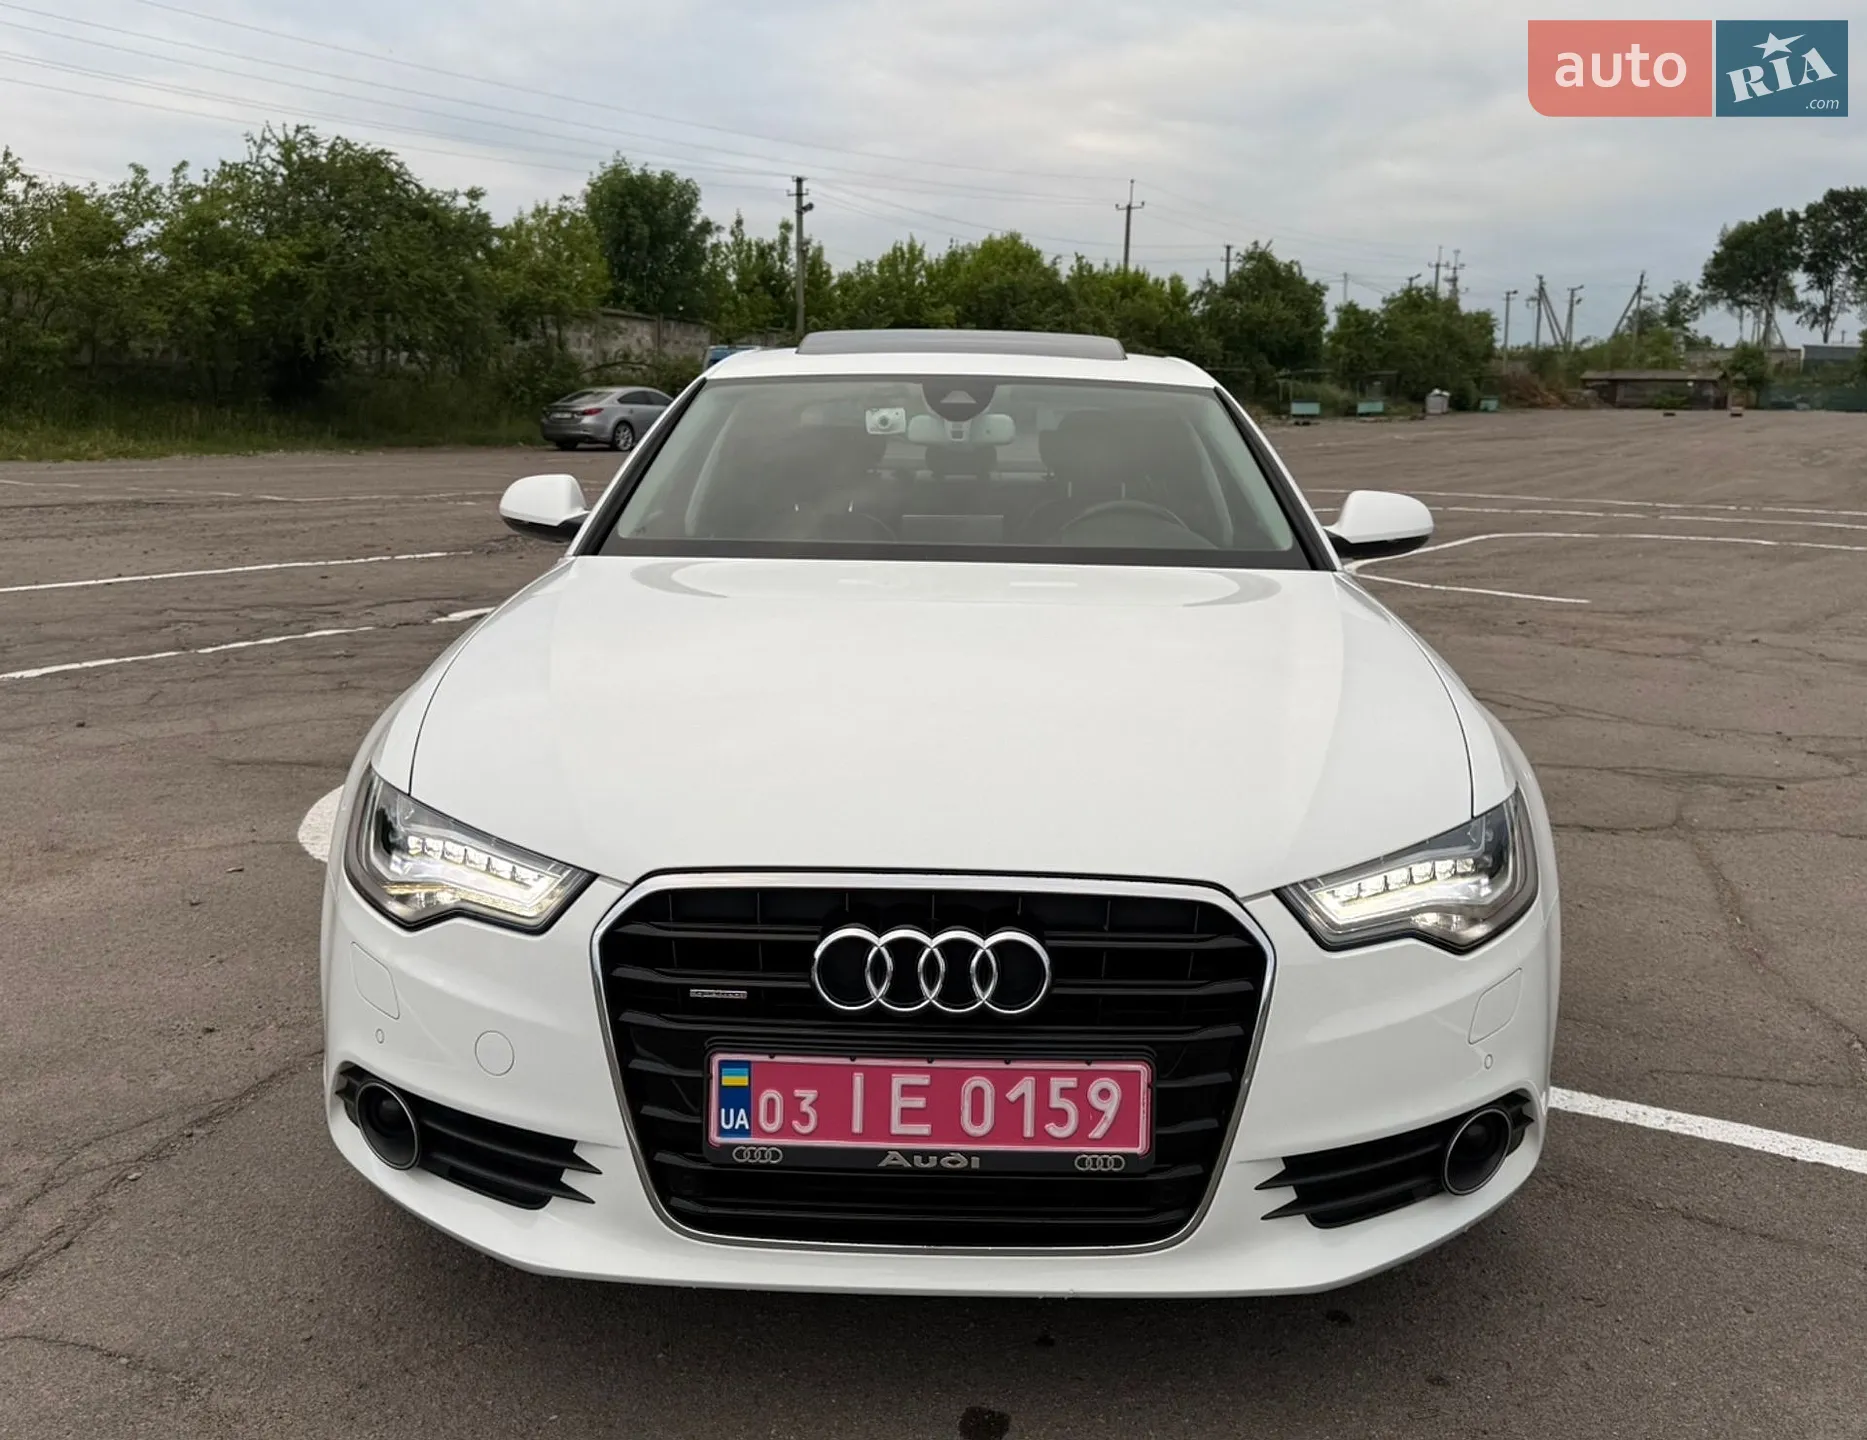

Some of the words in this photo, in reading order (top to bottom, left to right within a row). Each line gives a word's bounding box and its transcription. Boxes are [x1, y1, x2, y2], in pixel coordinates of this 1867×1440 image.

[720, 1107, 750, 1130] UA
[758, 1089, 818, 1134] 03
[960, 1075, 1122, 1139] 0159
[877, 1150, 981, 1170] Audi
